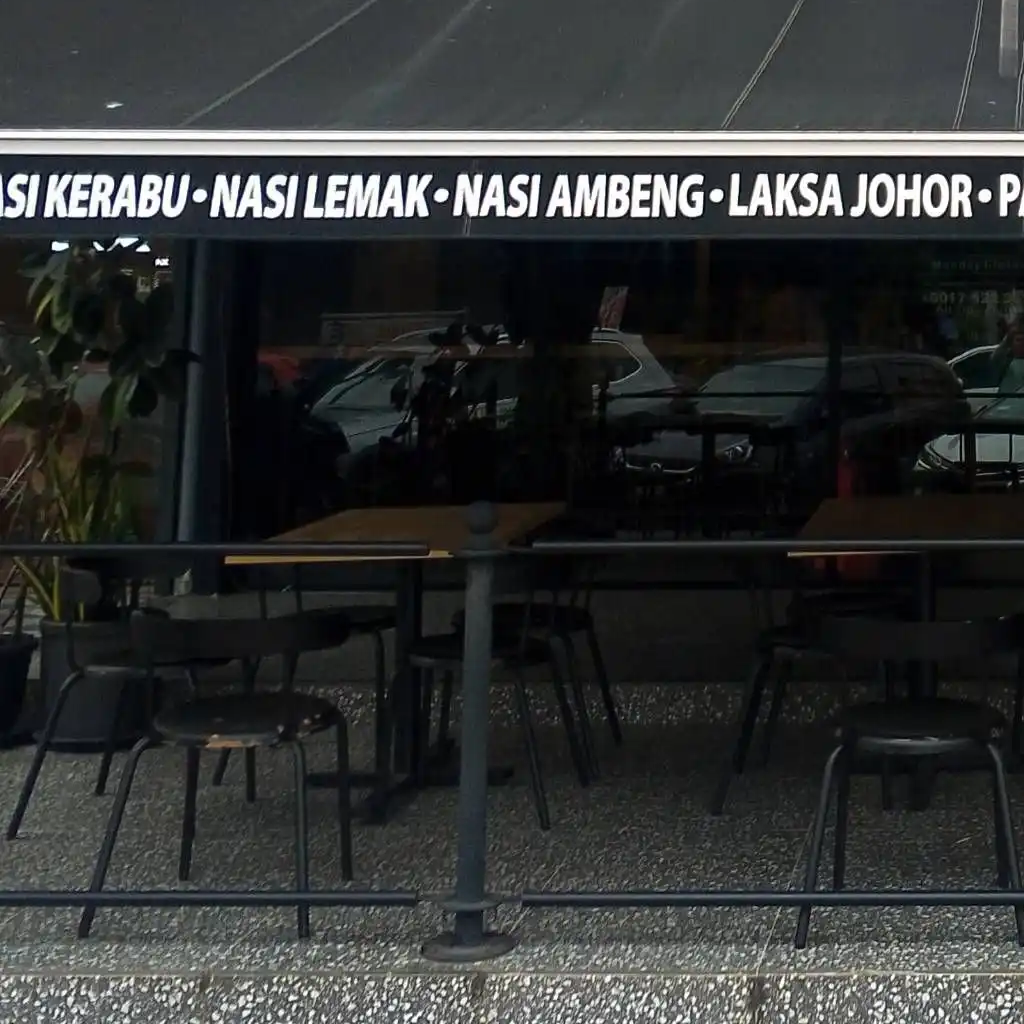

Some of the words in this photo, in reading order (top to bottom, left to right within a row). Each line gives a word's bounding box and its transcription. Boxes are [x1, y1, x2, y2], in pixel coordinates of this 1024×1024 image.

[0, 173, 41, 219] SI
[43, 174, 191, 219] KERABU
[209, 174, 299, 219] NASI
[303, 174, 433, 219] LEMAK
[452, 173, 541, 219] NASI
[545, 173, 705, 219] AMBENG
[728, 172, 844, 218] LAKSA
[849, 172, 973, 219] JOHOR
